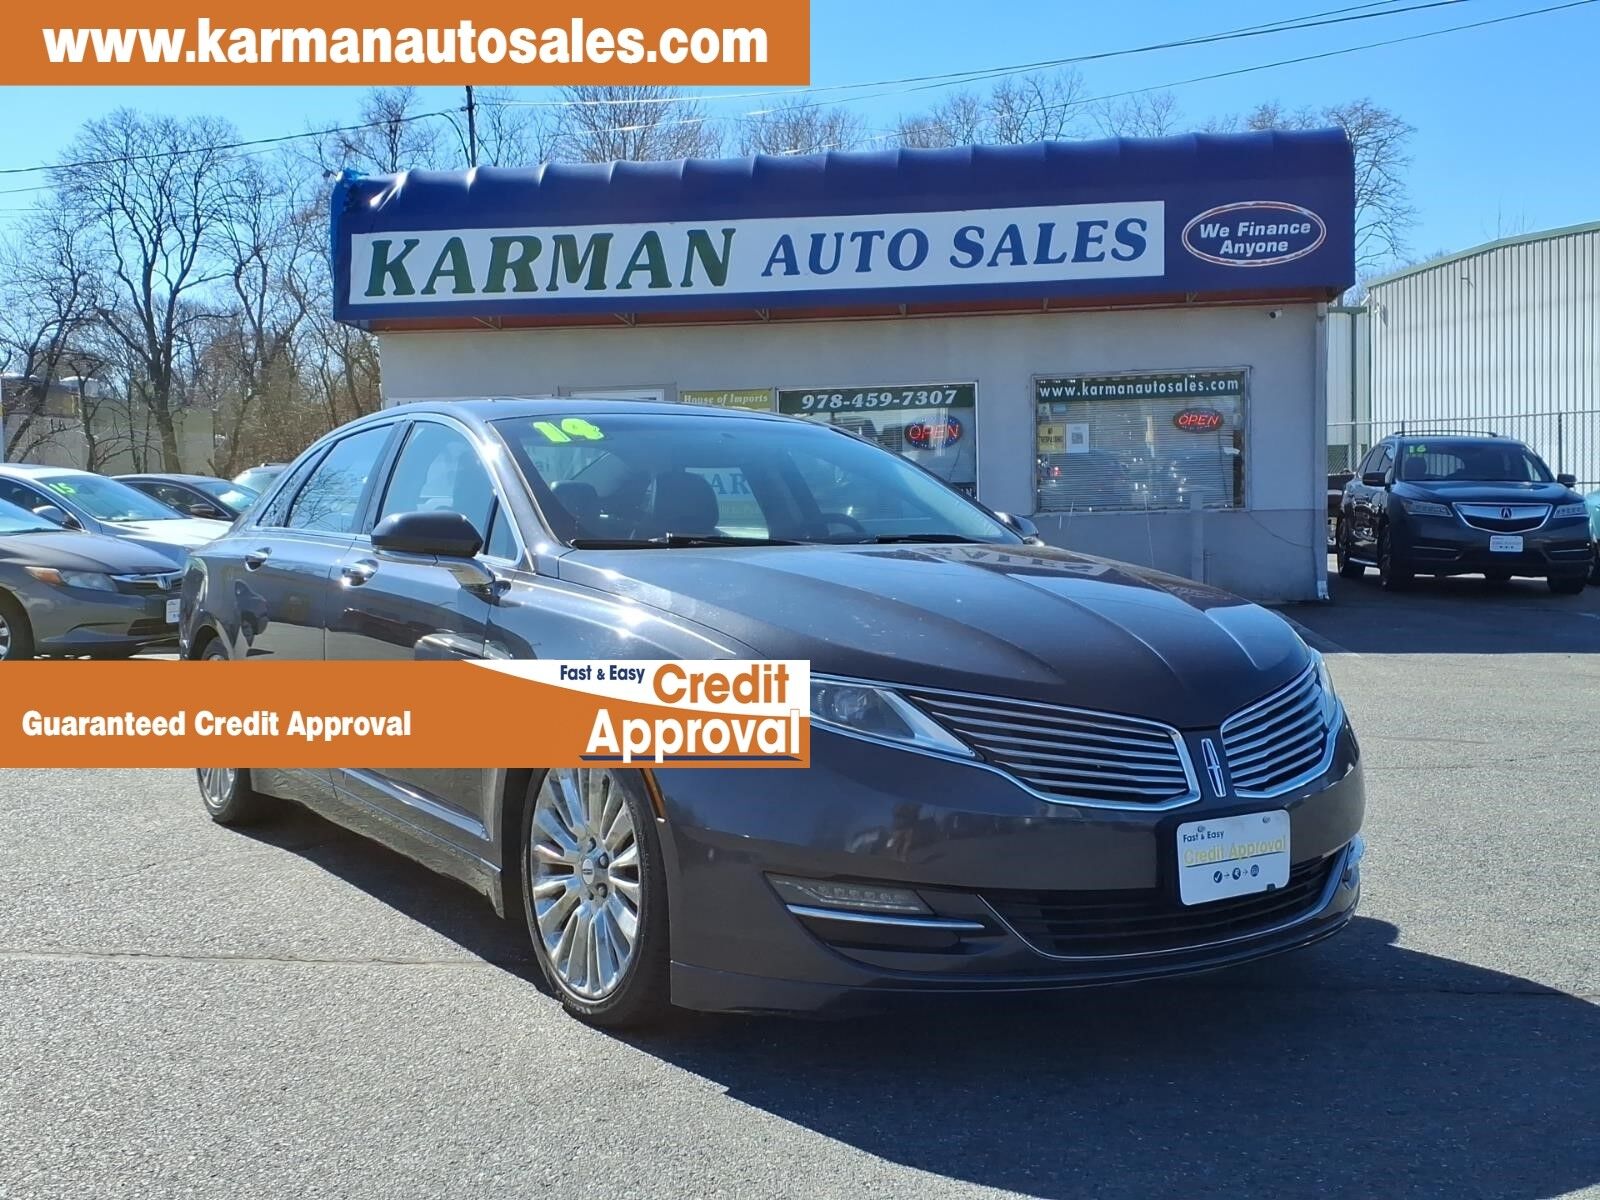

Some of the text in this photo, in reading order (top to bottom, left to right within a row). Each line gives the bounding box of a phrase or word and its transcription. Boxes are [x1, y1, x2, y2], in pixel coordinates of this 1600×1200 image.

[1200, 221, 1312, 239] We Finance
[1219, 239, 1289, 257] Anyone
[364, 217, 1148, 297] KARMAN AUTO SALES
[1039, 377, 1239, 398] www.karmanautosales.com
[683, 393, 768, 407] House of Imports
[801, 389, 958, 410] 978-459-7307
[1178, 414, 1220, 427] OPEN
[908, 424, 960, 440] OPEN
[1408, 443, 1427, 454] 16
[48, 482, 76, 495] 15
[1183, 832, 1199, 843] Fast
[1206, 830, 1225, 841] Easy
[1184, 835, 1286, 866] Credit Approval
